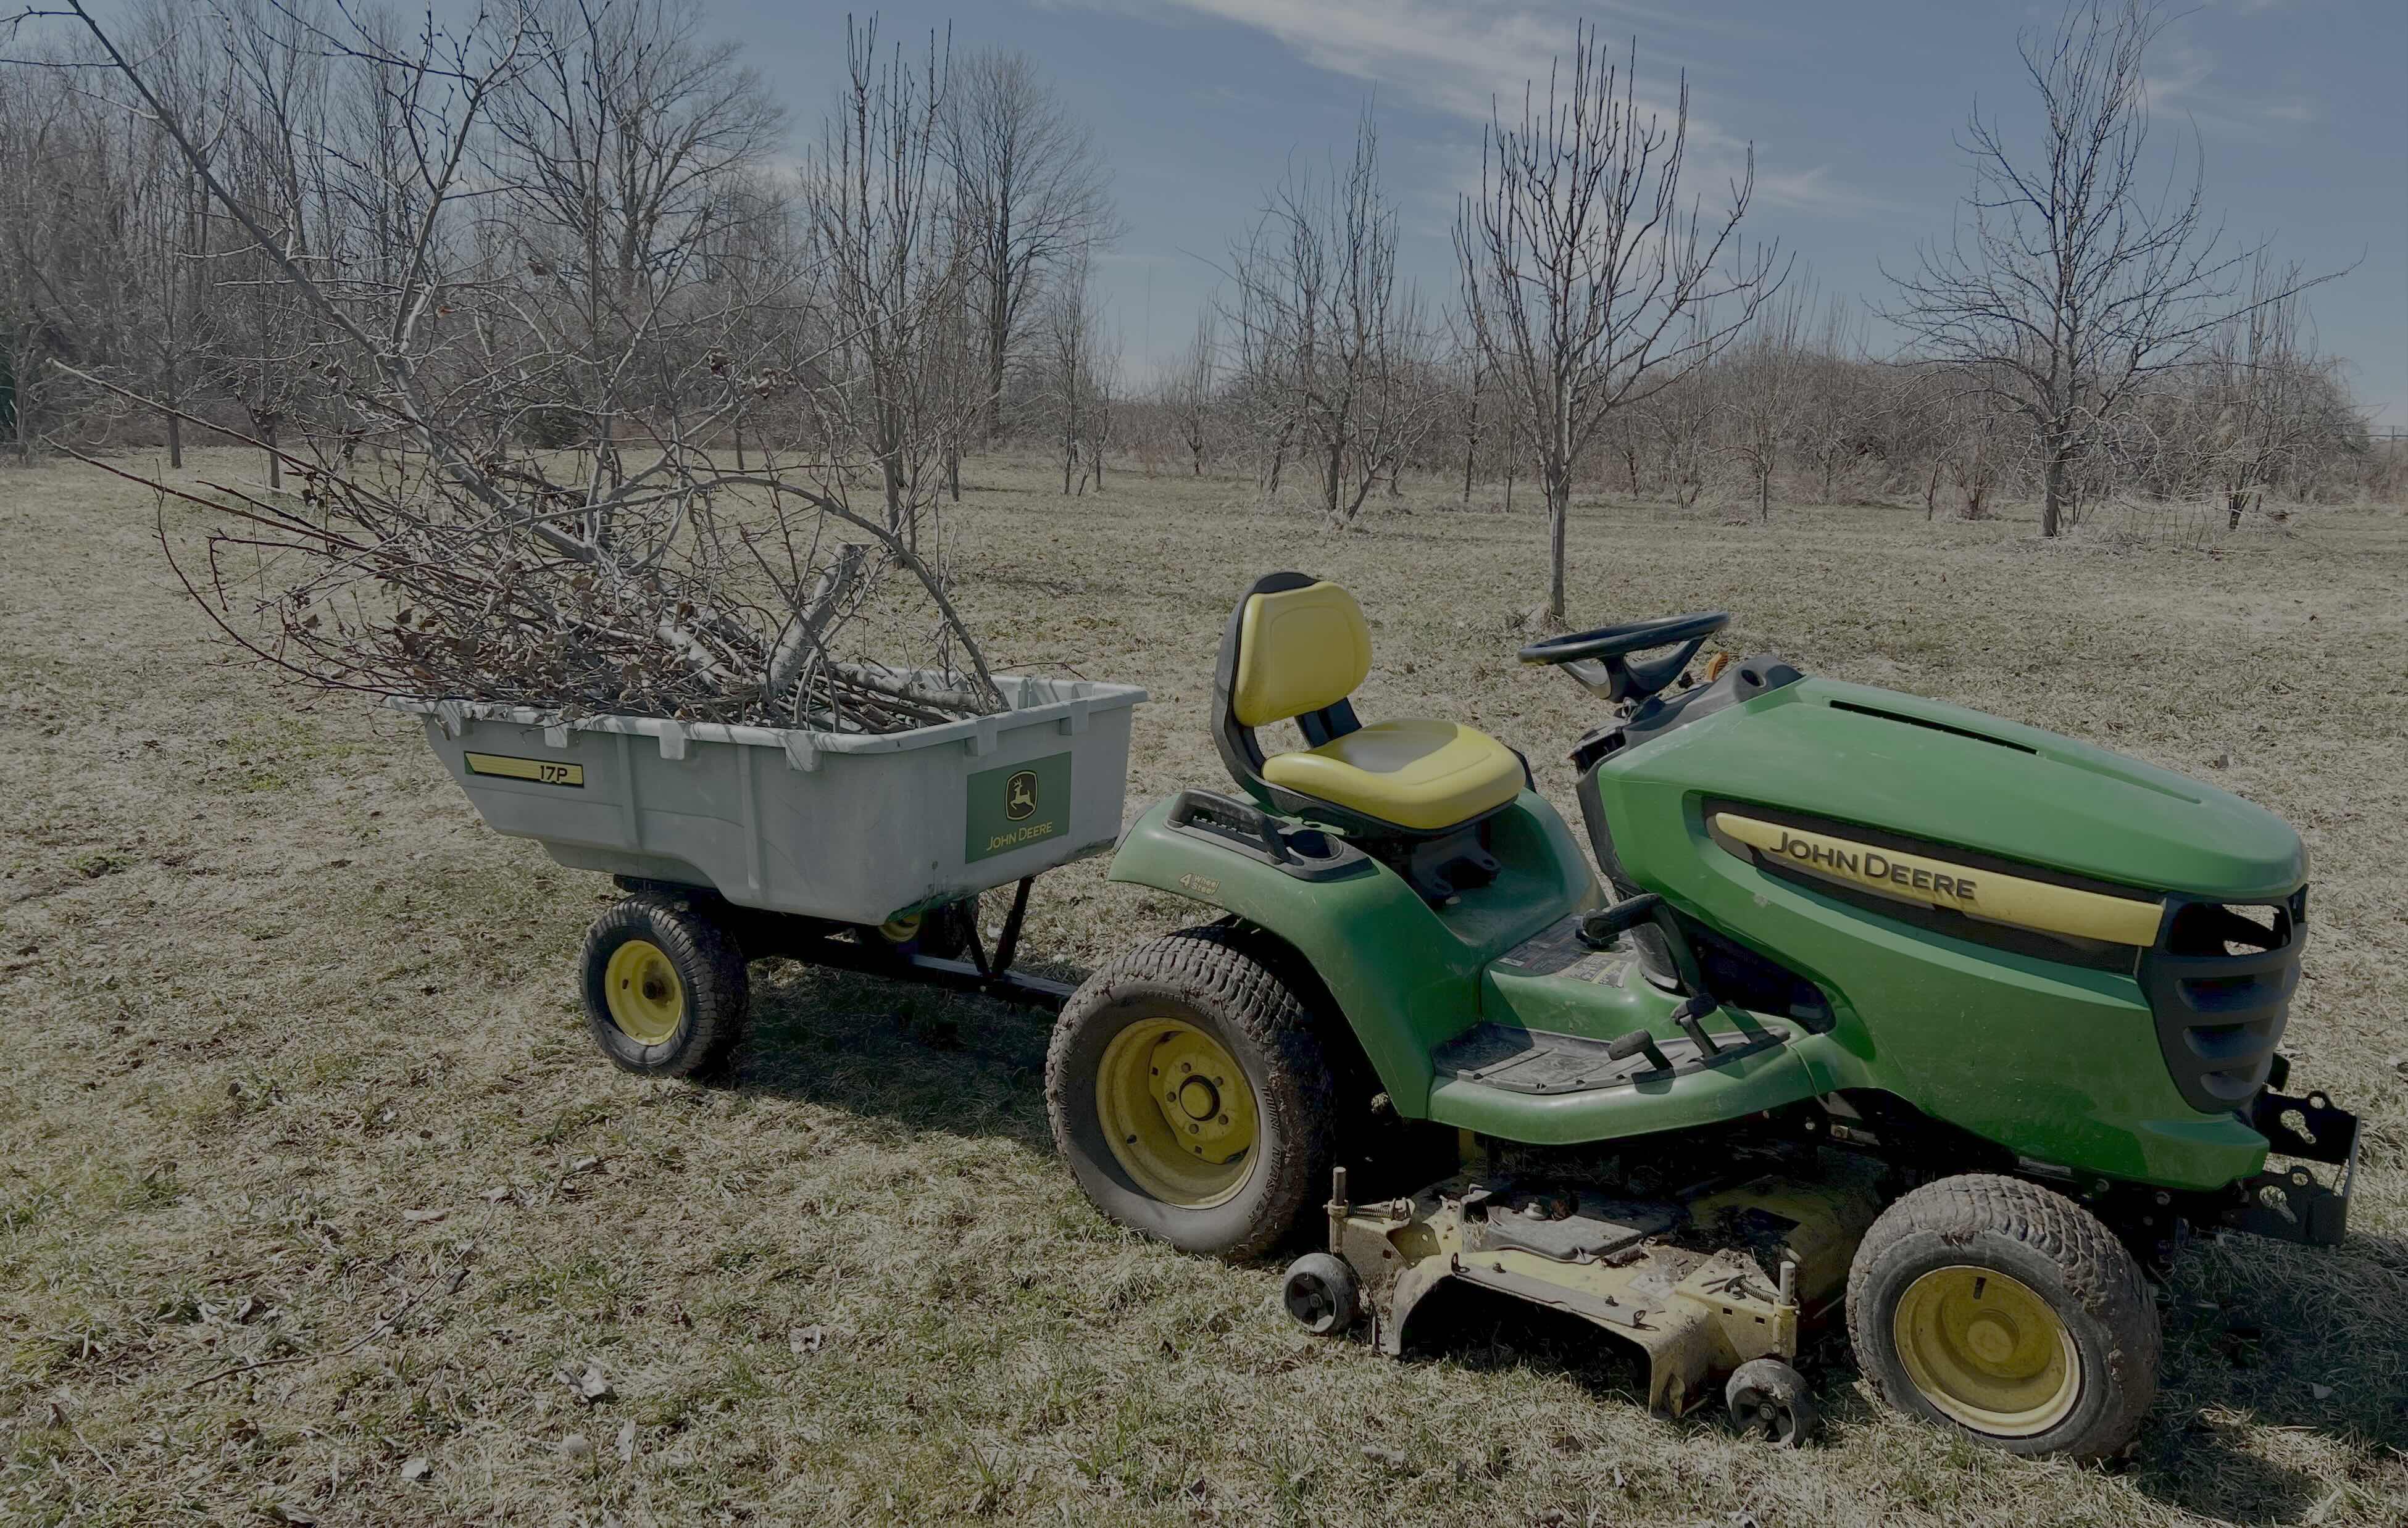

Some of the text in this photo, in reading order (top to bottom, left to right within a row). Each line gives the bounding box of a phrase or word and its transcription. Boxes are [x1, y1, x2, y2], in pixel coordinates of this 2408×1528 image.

[540, 765, 568, 782] 17P
[986, 821, 1052, 851] JOHN DEERE
[1769, 831, 1978, 900] JOHN DEERE
[1179, 873, 1220, 889] 4 Wheel
[1191, 882, 1217, 895] Steer
